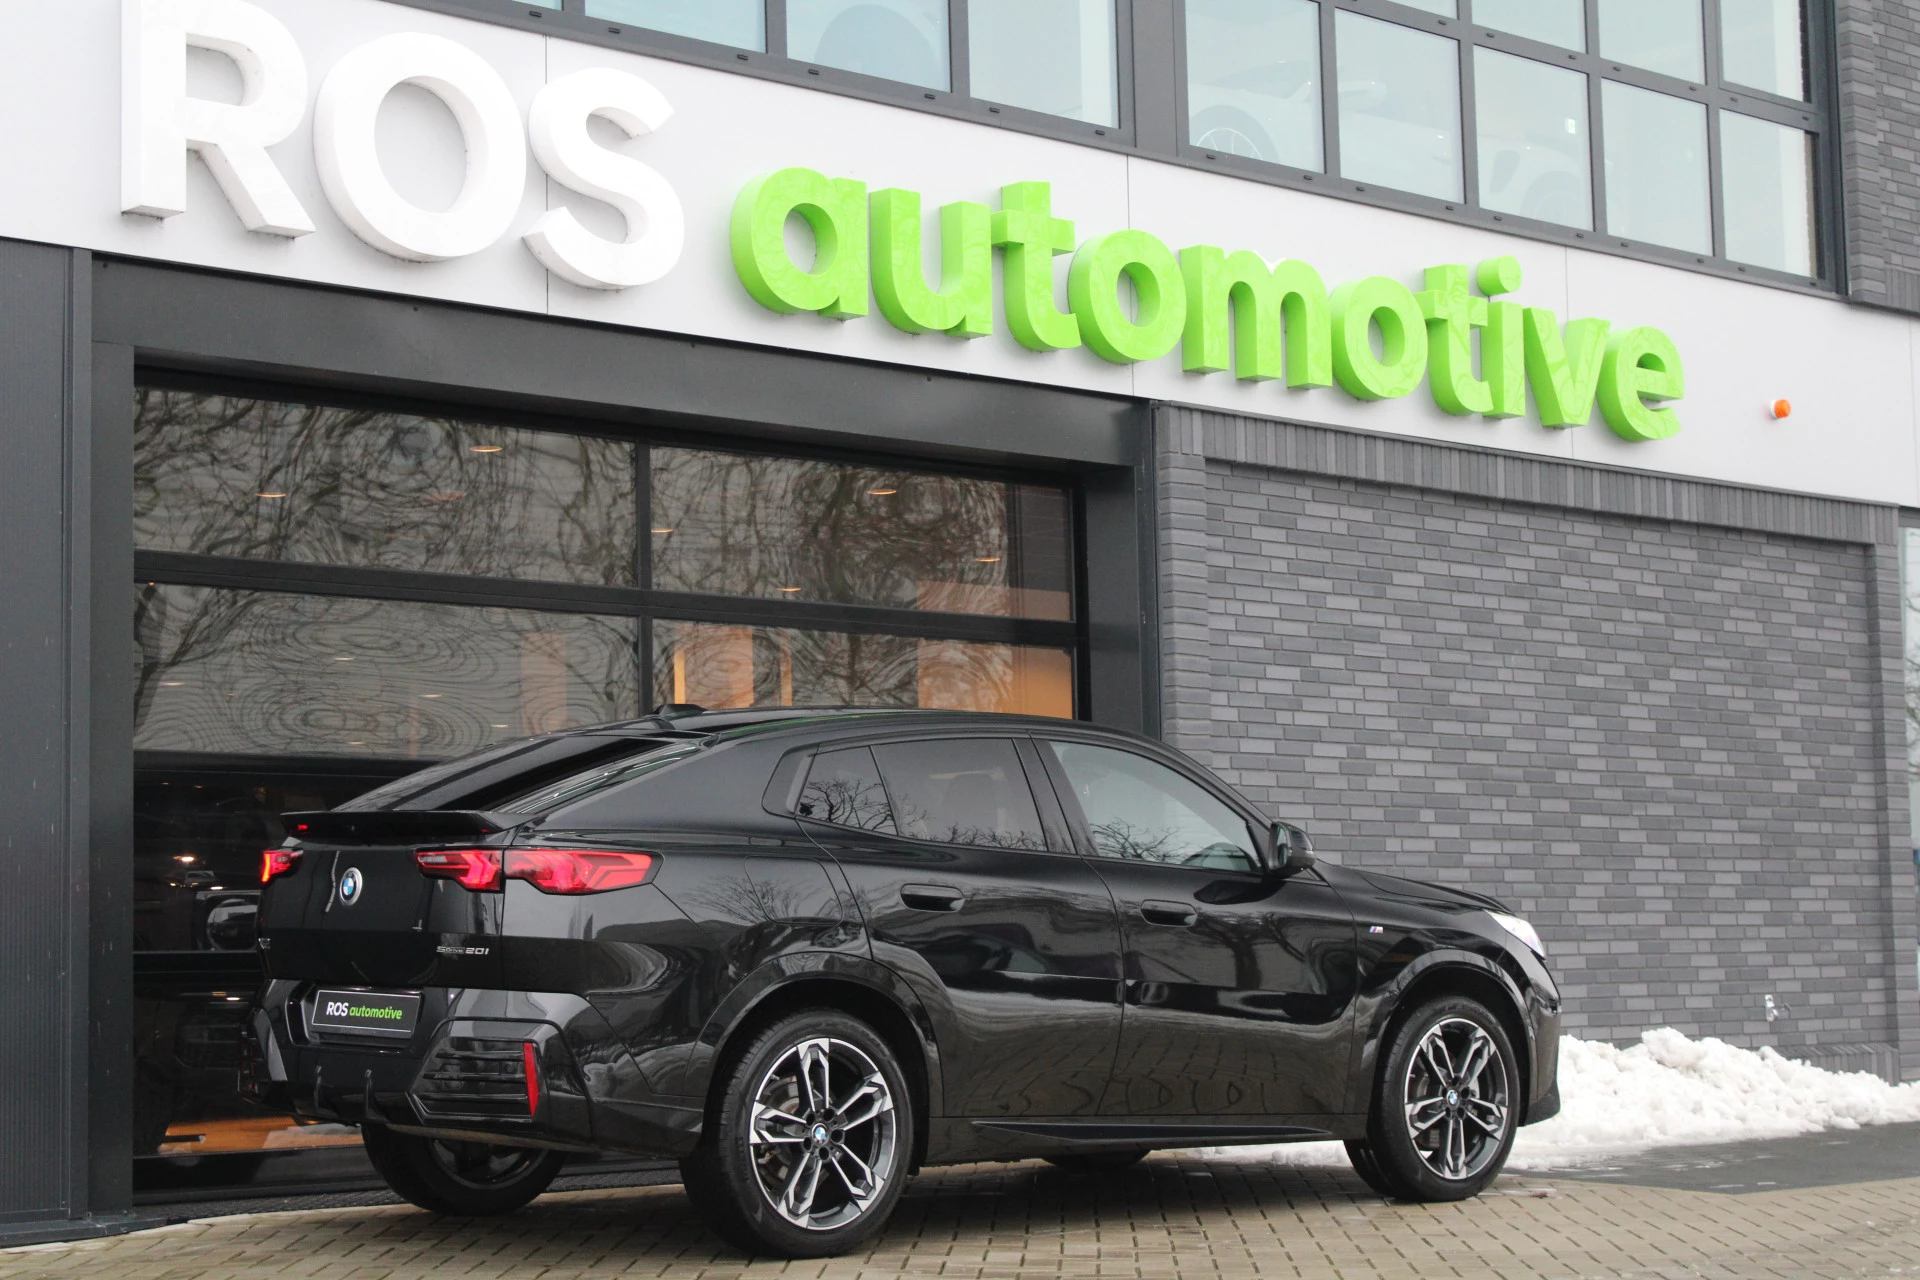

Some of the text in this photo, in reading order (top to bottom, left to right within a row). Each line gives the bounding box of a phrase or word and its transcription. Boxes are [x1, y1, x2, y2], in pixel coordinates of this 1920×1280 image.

[121, 0, 1684, 442] ROS automotive
[326, 1001, 402, 1020] ROS automotive
